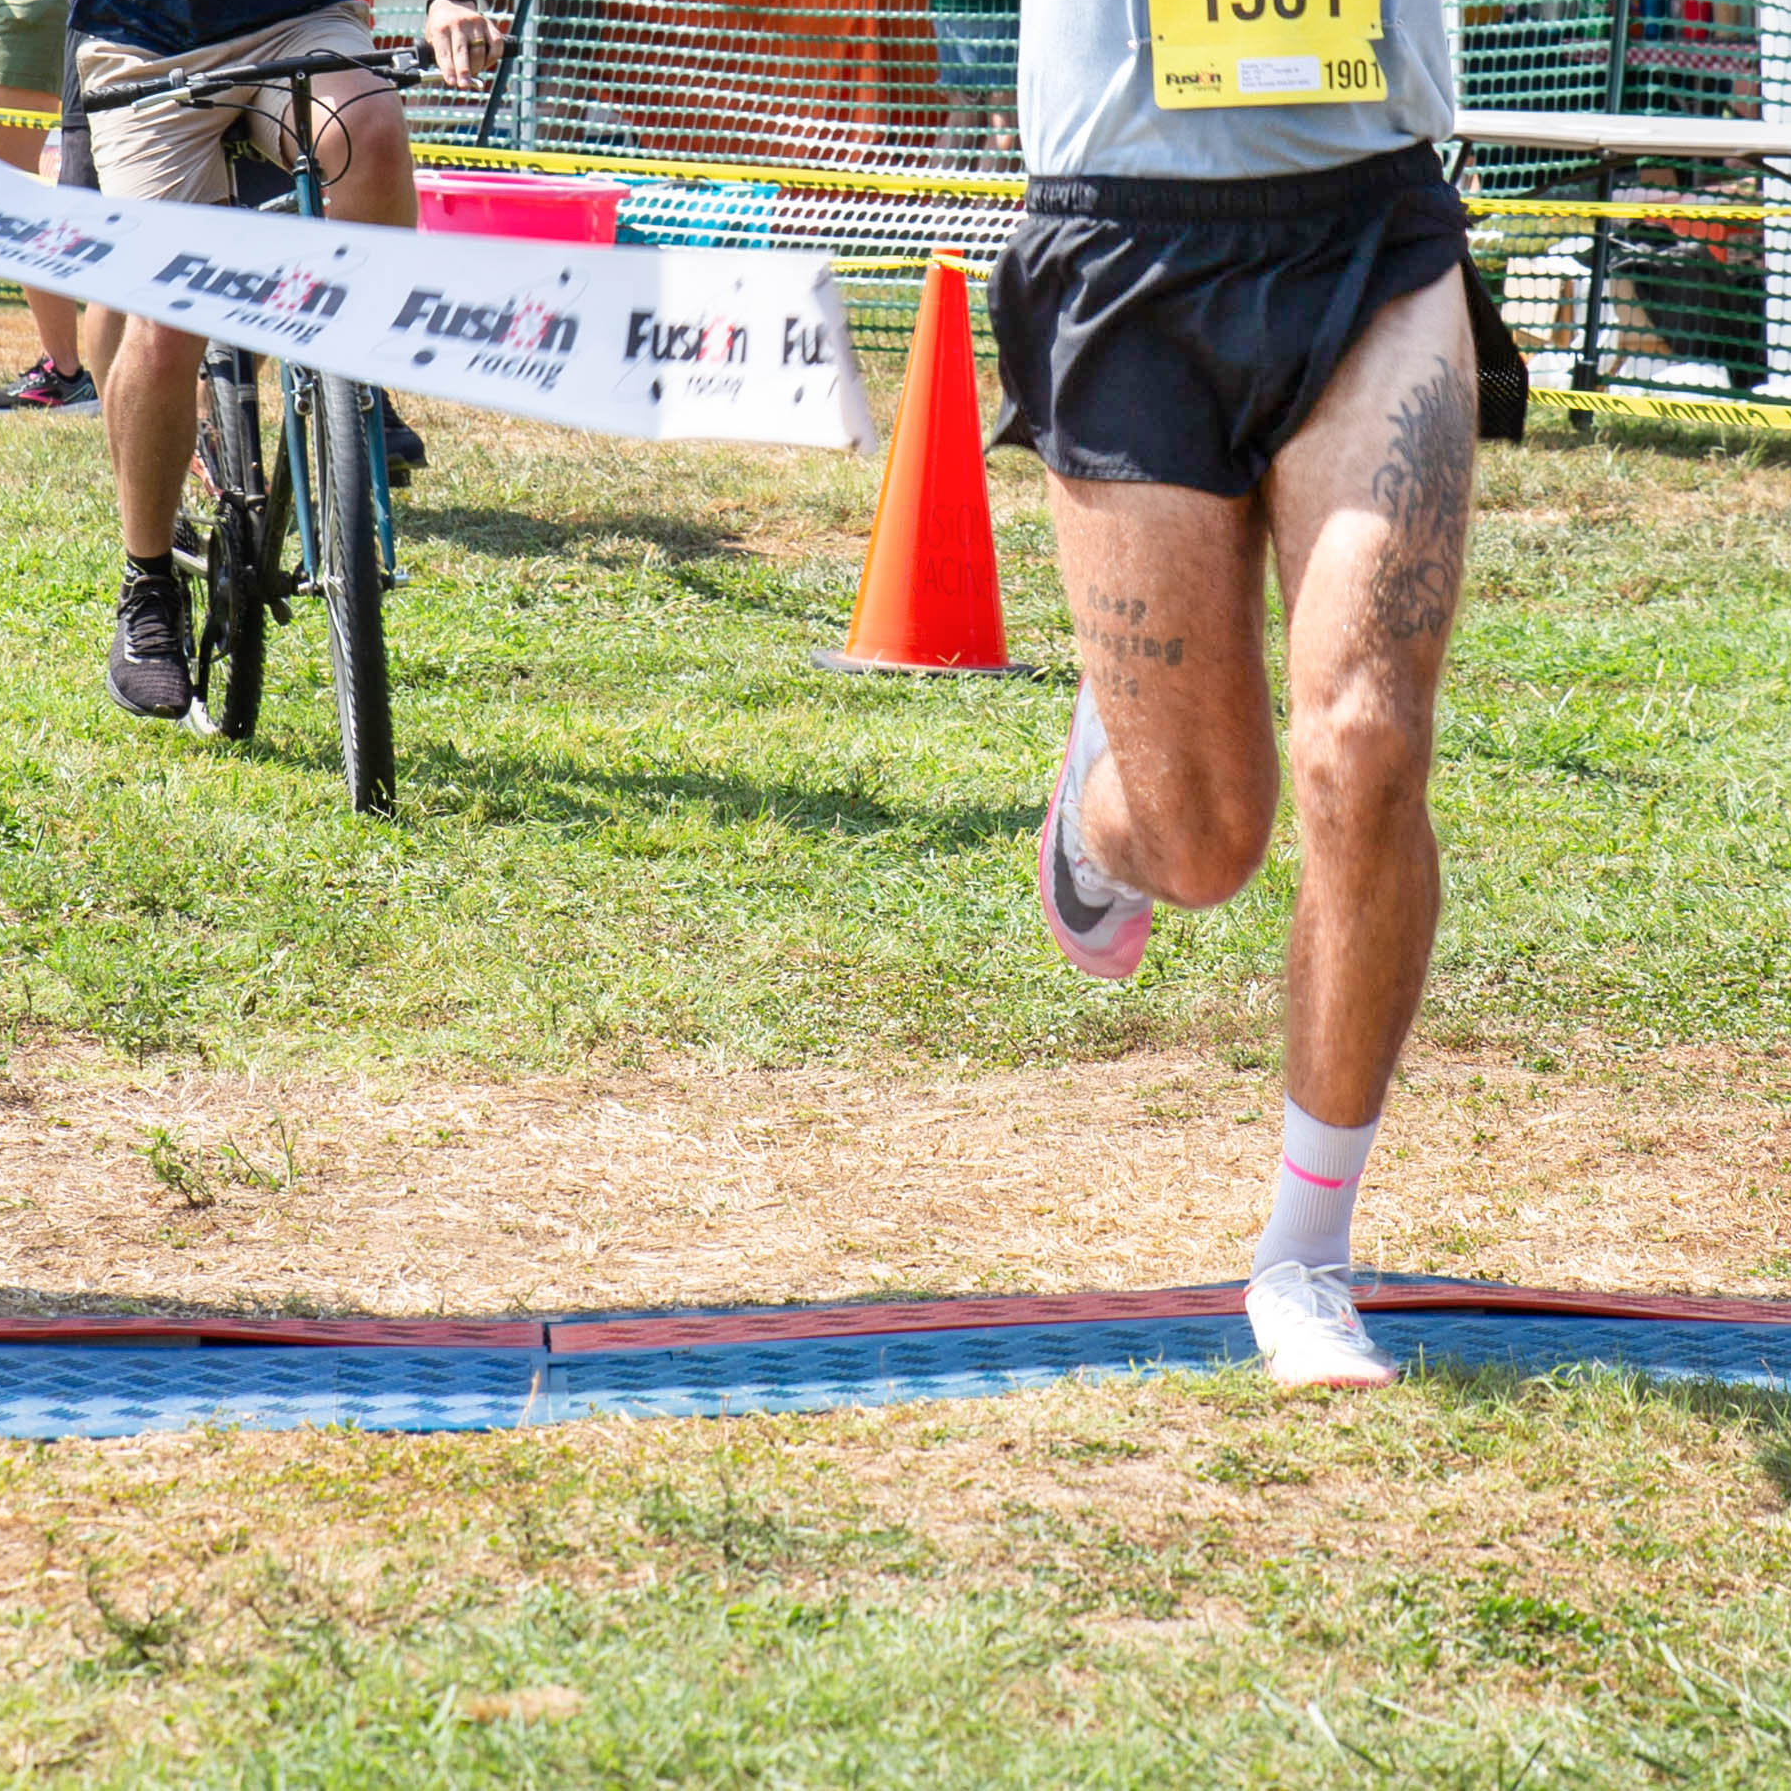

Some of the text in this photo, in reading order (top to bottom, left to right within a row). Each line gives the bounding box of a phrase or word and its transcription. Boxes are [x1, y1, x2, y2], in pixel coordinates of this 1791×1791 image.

[1324, 59, 1382, 90] 1901
[150, 253, 349, 318] Fusion
[387, 287, 580, 355] Fusion
